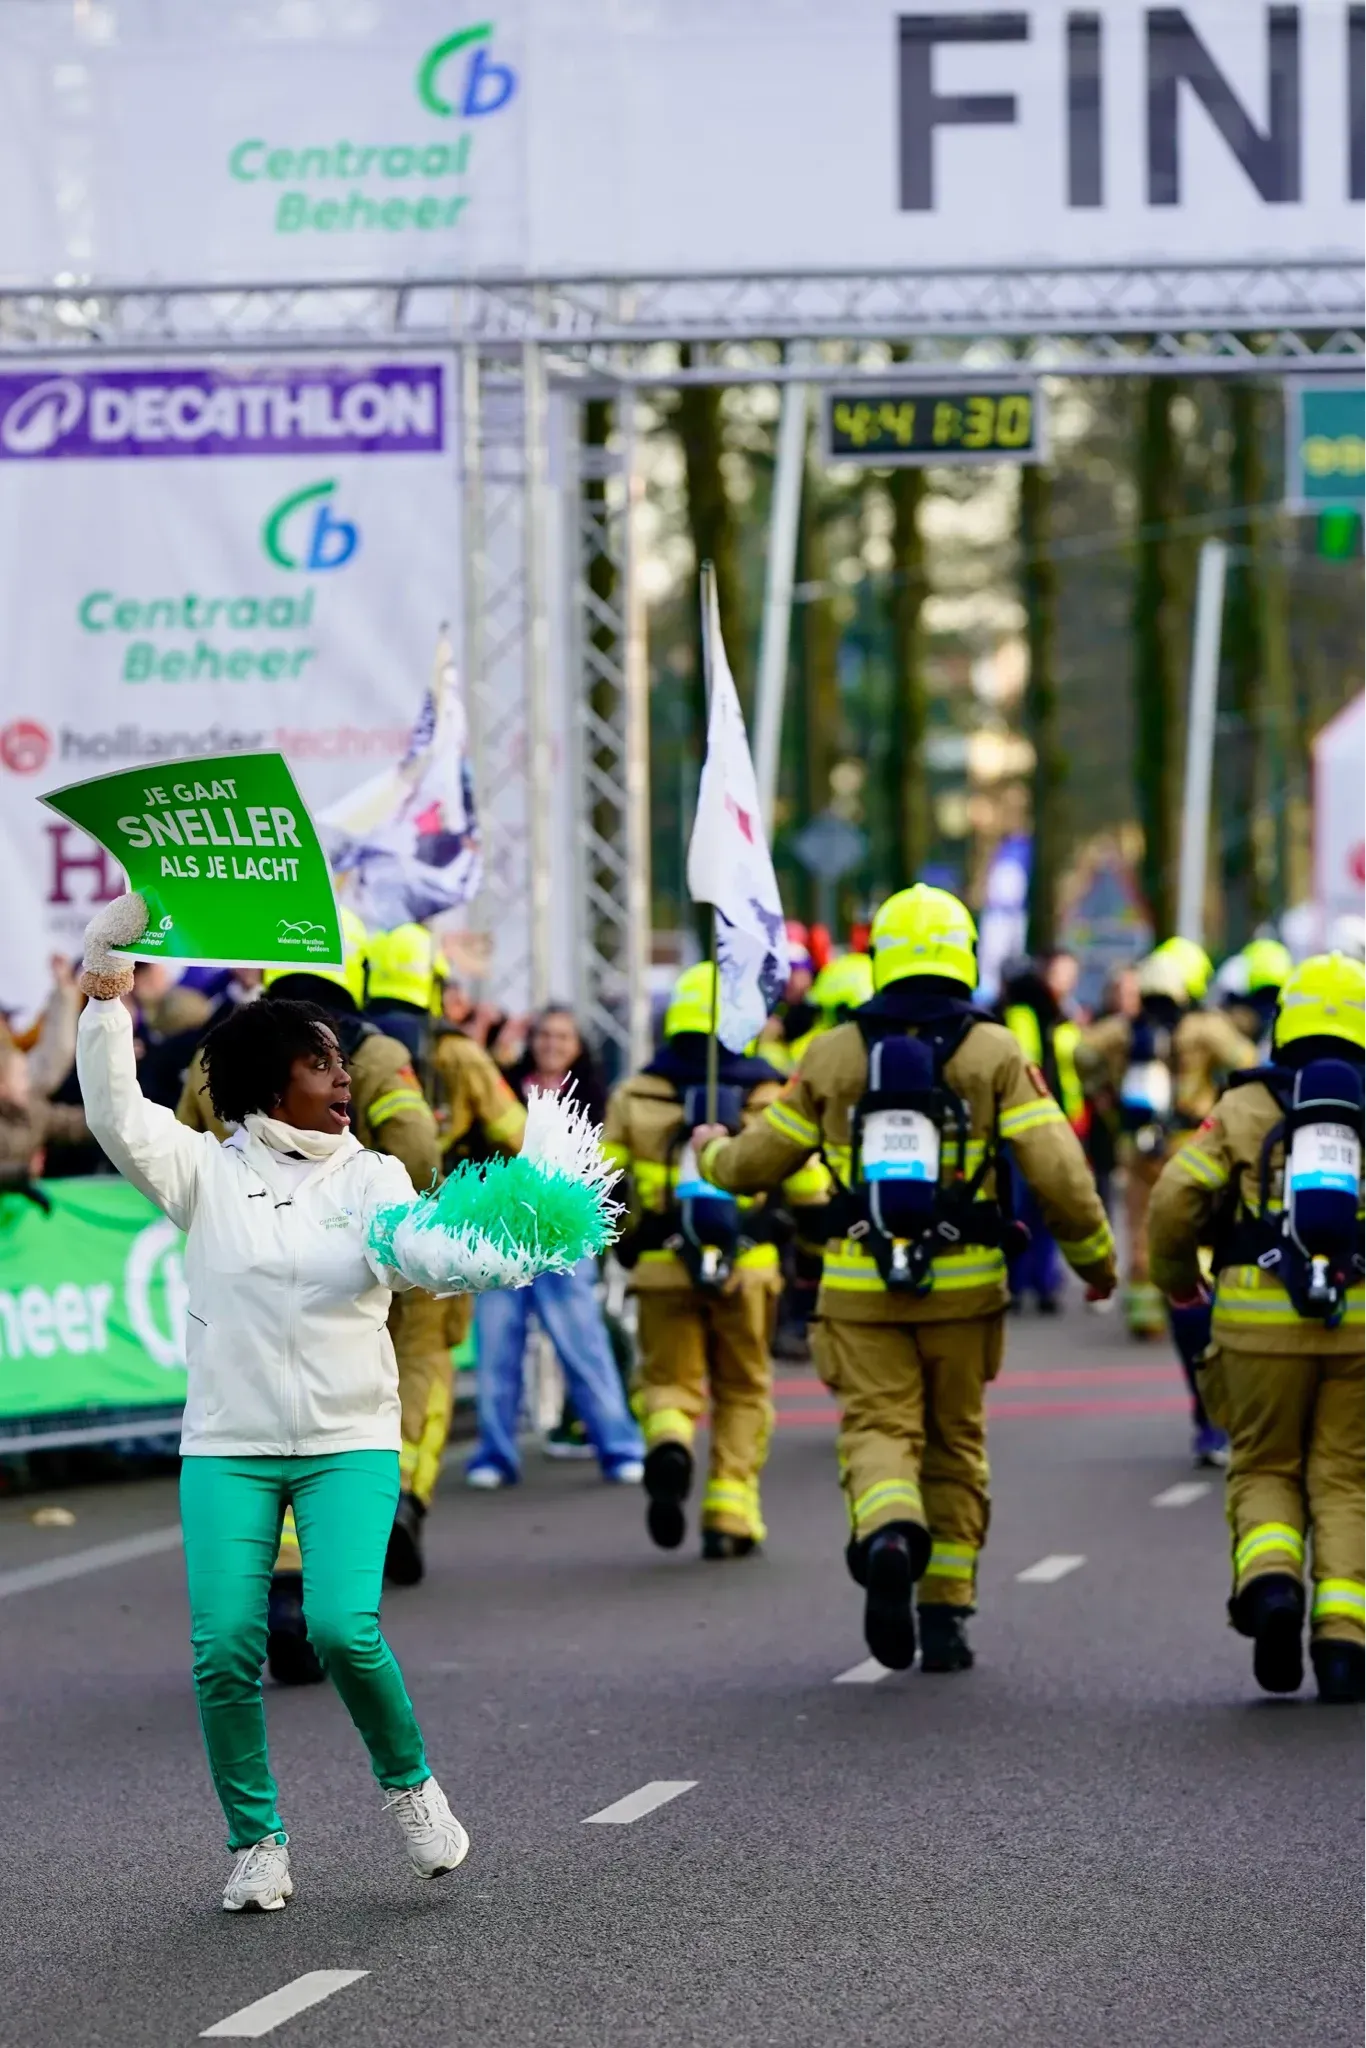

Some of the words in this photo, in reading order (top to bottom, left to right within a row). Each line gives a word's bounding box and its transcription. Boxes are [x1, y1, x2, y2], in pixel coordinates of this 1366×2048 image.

[229, 133, 471, 183] Centraal
[275, 191, 469, 235] Beheer
[90, 383, 436, 442] DECATHLON
[79, 588, 316, 634] Centraal
[122, 641, 316, 684] Beheer
[143, 787, 171, 806] JE
[173, 779, 238, 802] GAAT
[117, 806, 303, 849] SNELLER
[161, 855, 200, 878] ALS
[205, 856, 228, 879] JE
[231, 856, 300, 882] LACHT
